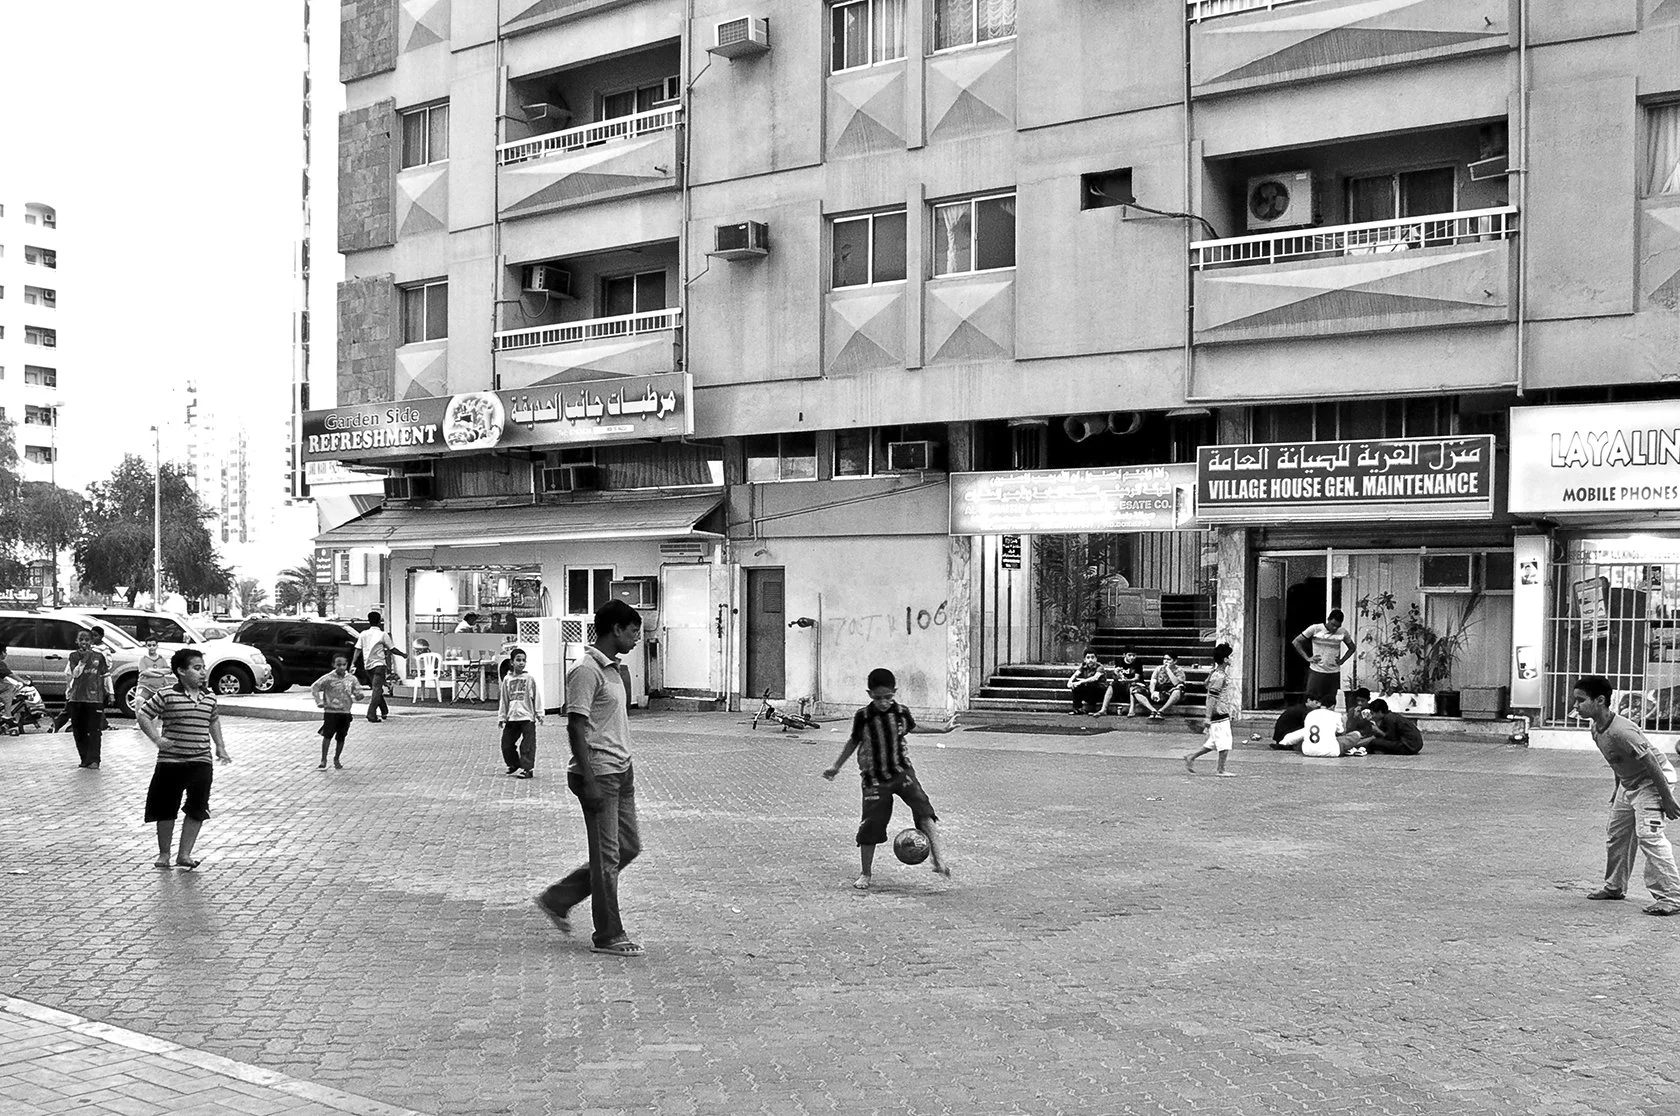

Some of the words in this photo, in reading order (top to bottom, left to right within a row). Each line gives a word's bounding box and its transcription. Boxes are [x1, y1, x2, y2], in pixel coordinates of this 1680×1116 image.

[511, 391, 563, 430] الحديقة
[564, 388, 605, 426] جانب
[606, 383, 677, 420] مرطبات
[324, 411, 380, 430] Garden
[386, 406, 421, 424] Side
[308, 423, 438, 453] REFRESHMENT
[1208, 446, 1270, 472] العامة
[1277, 444, 1351, 474] للصيانة
[1356, 442, 1419, 473] القرية
[1427, 440, 1482, 471] منزل
[1208, 478, 1268, 500] VILLAGE
[1270, 476, 1322, 499] HOUSE
[1325, 474, 1360, 498] GEN.
[1362, 471, 1479, 496] MAINTENANCE
[1562, 486, 1617, 502] MOBILE
[1620, 485, 1679, 500] PHONES
[1119, 500, 1152, 510] ESATE
[1153, 499, 1172, 509] CO.
[905, 599, 948, 636] 106
[1309, 724, 1321, 745] 8
